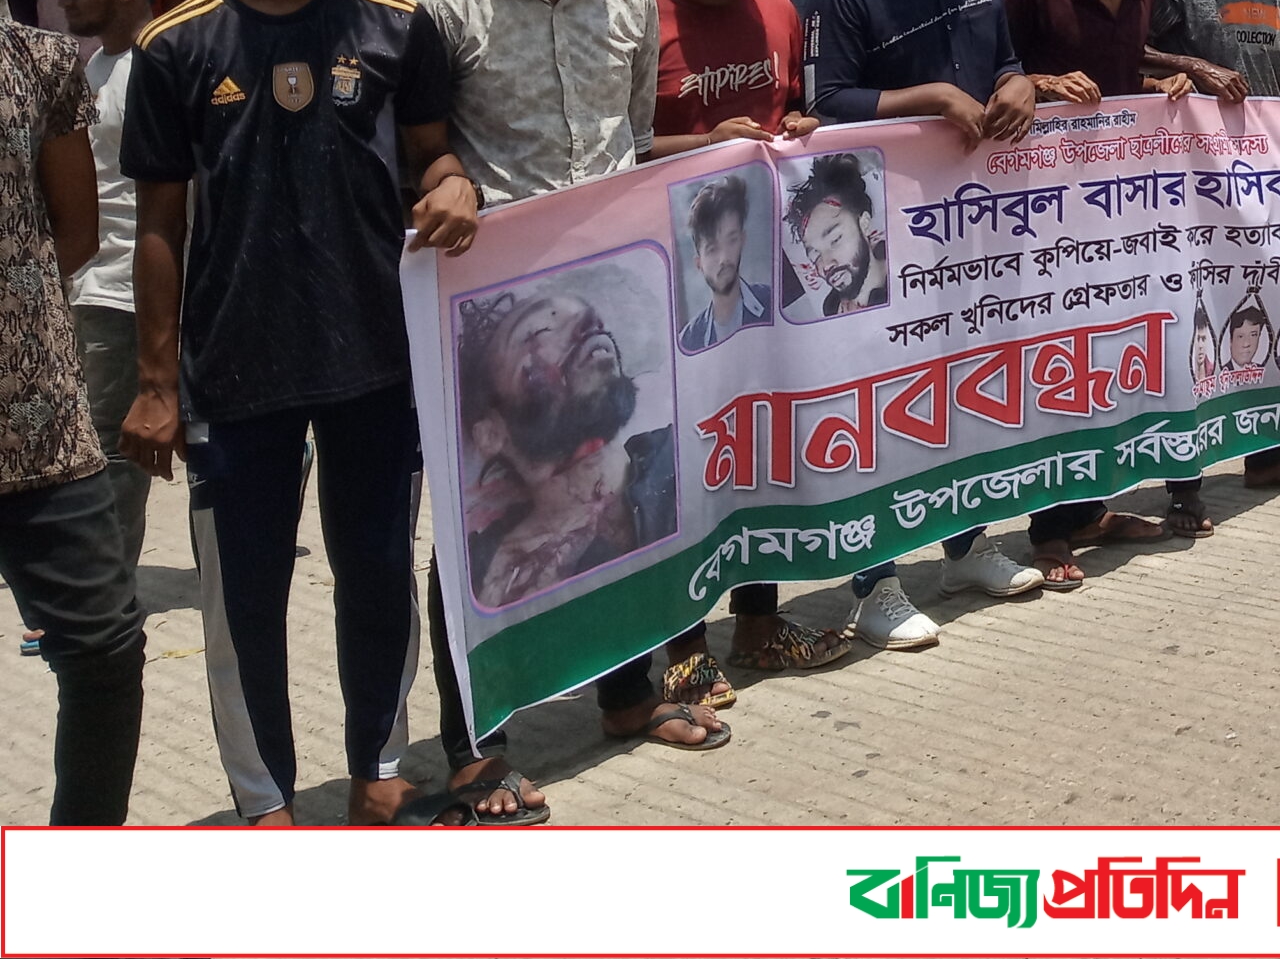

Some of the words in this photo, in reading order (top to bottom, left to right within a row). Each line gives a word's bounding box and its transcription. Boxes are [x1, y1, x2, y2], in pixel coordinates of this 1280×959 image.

[211, 92, 246, 106] adidas
[901, 182, 1070, 246] হাসিবুল
[1081, 168, 1186, 221] বাসার
[898, 253, 1024, 299] নির্মমভাবে
[886, 309, 954, 348] সকল
[961, 289, 1055, 335] খুনিদের
[697, 311, 1178, 491] মানববন্ধন
[688, 513, 876, 601] বেগমগঞ্জ
[889, 448, 1106, 529] উপজেলার
